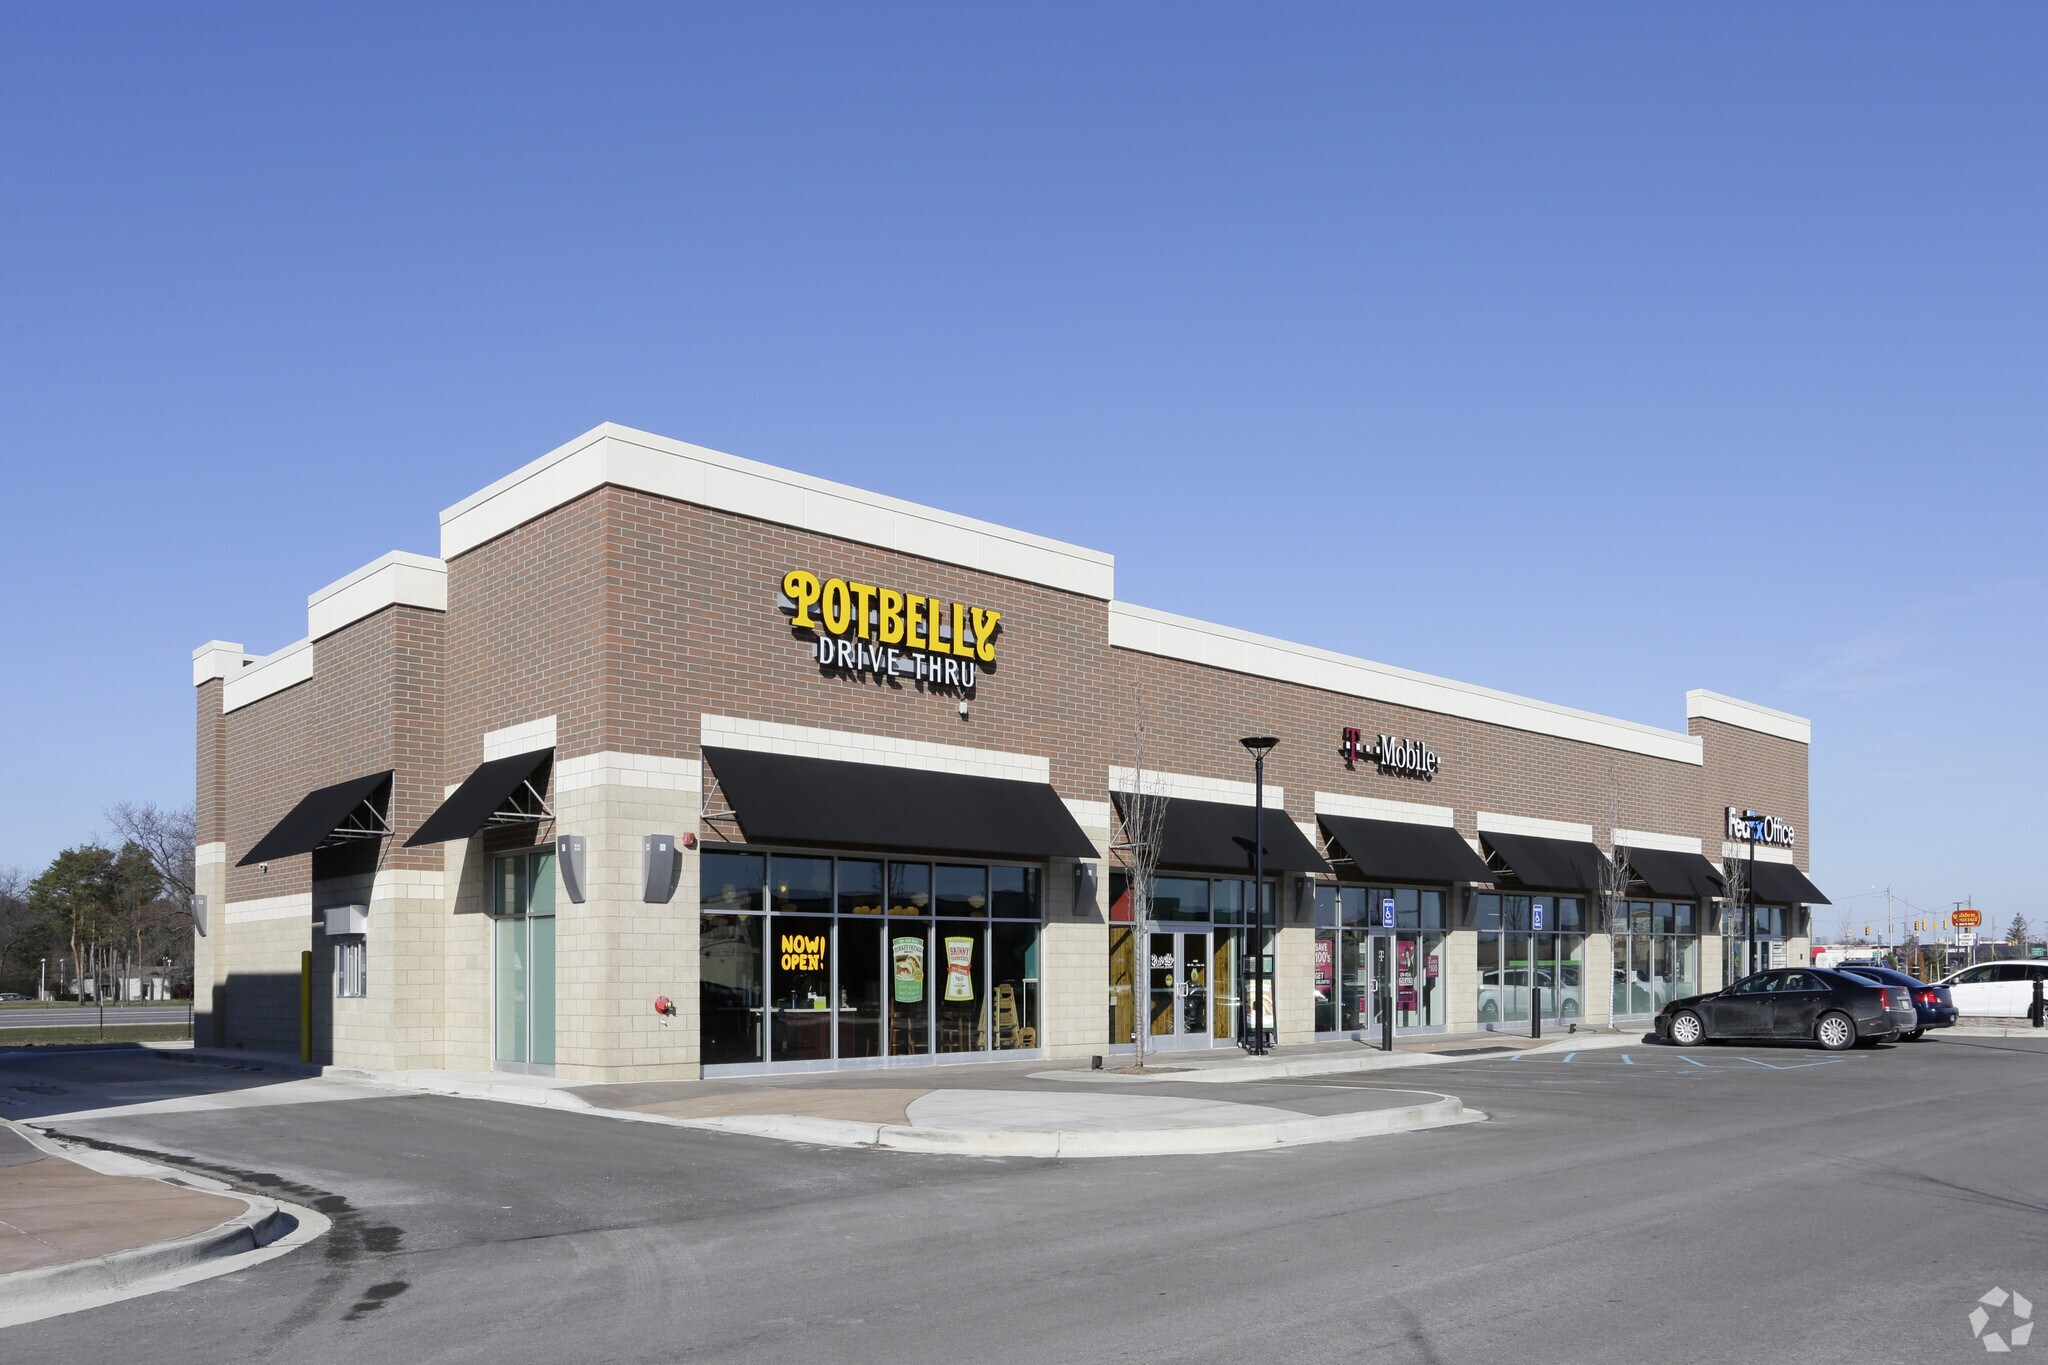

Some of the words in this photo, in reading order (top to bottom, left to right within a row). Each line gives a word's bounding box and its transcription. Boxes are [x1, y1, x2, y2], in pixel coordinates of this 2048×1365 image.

[784, 570, 1001, 662] POTBELLY
[819, 636, 900, 676] DRIVE
[912, 653, 974, 688] THRU
[1764, 815, 1795, 845] Office
[1315, 942, 1328, 951] SAVE
[1315, 951, 1331, 963] 100's
